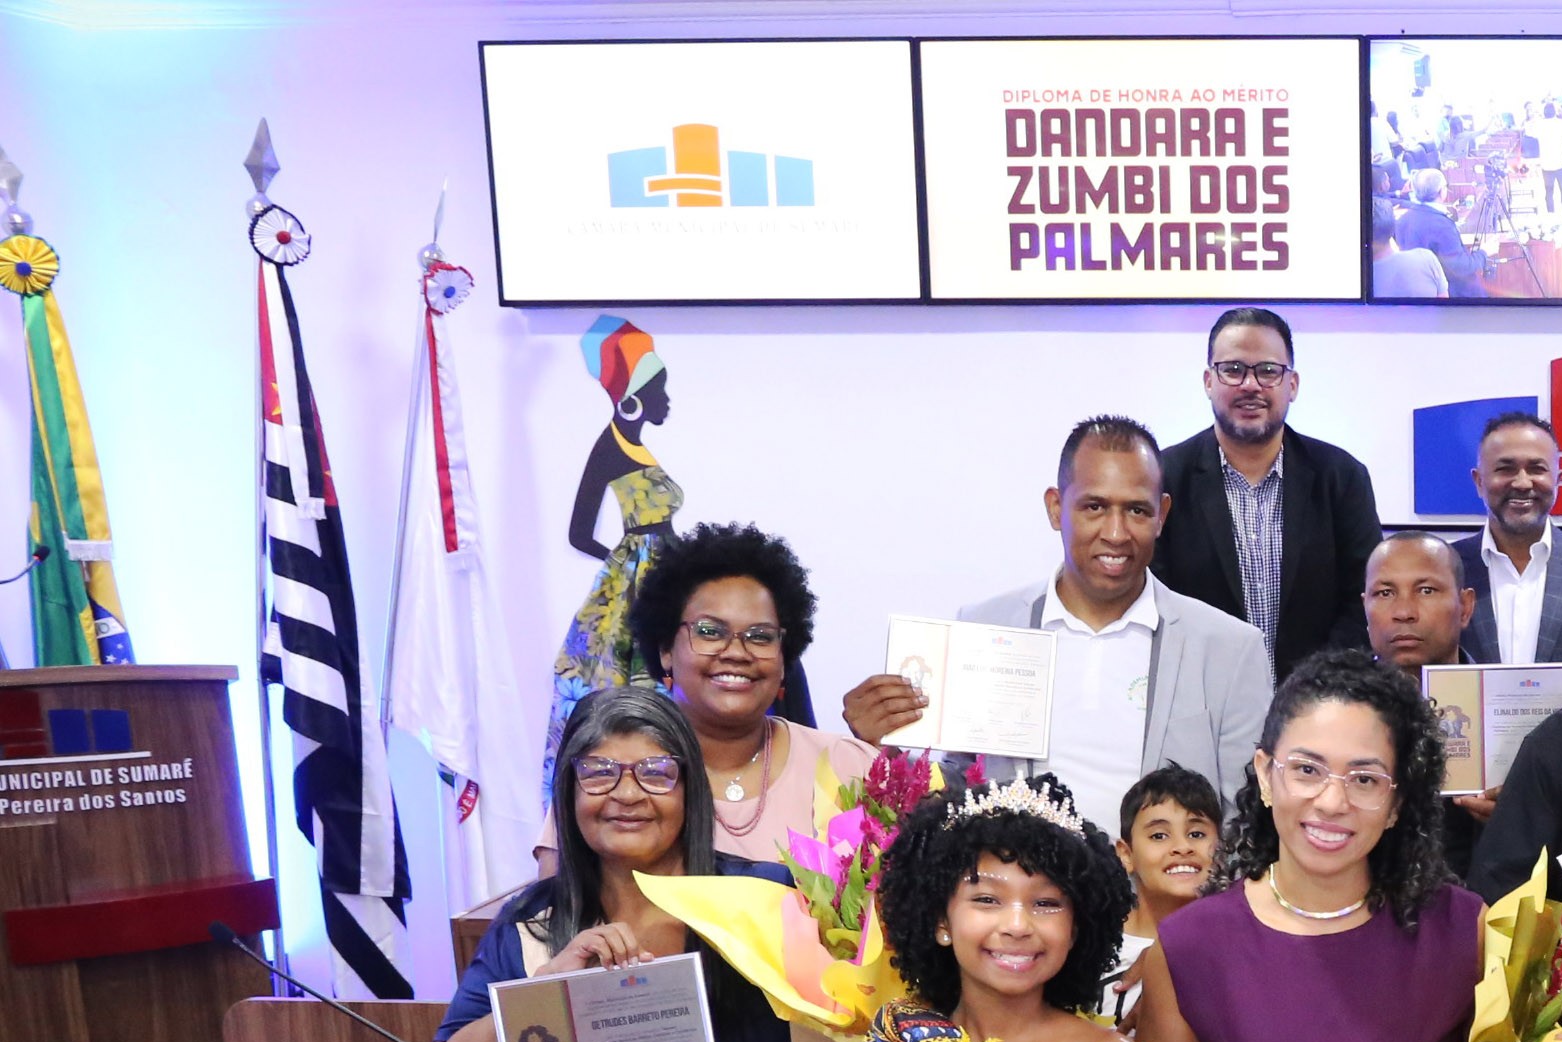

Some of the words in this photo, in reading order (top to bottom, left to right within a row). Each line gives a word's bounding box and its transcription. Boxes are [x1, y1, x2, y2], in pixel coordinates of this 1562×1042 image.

[1003, 89, 1083, 103] DIPLOMA
[1090, 89, 1111, 102] DE
[1118, 89, 1183, 102] HONRA
[1190, 89, 1216, 102] AO
[1222, 84, 1289, 102] MÉRITO
[1005, 108, 1247, 157] DANDARA
[1262, 108, 1289, 156] E
[1006, 165, 1171, 214] ZUMBI
[1189, 165, 1290, 214] DOS
[1009, 222, 1290, 271] PALMARES
[0, 770, 86, 791] UNICIPAL
[91, 768, 114, 786] DE
[118, 758, 193, 784] SUMARÉ
[0, 797, 74, 815] Pereira
[79, 794, 115, 811] dos
[119, 789, 187, 807] Santos
[629, 1011, 660, 1026] BARRETO
